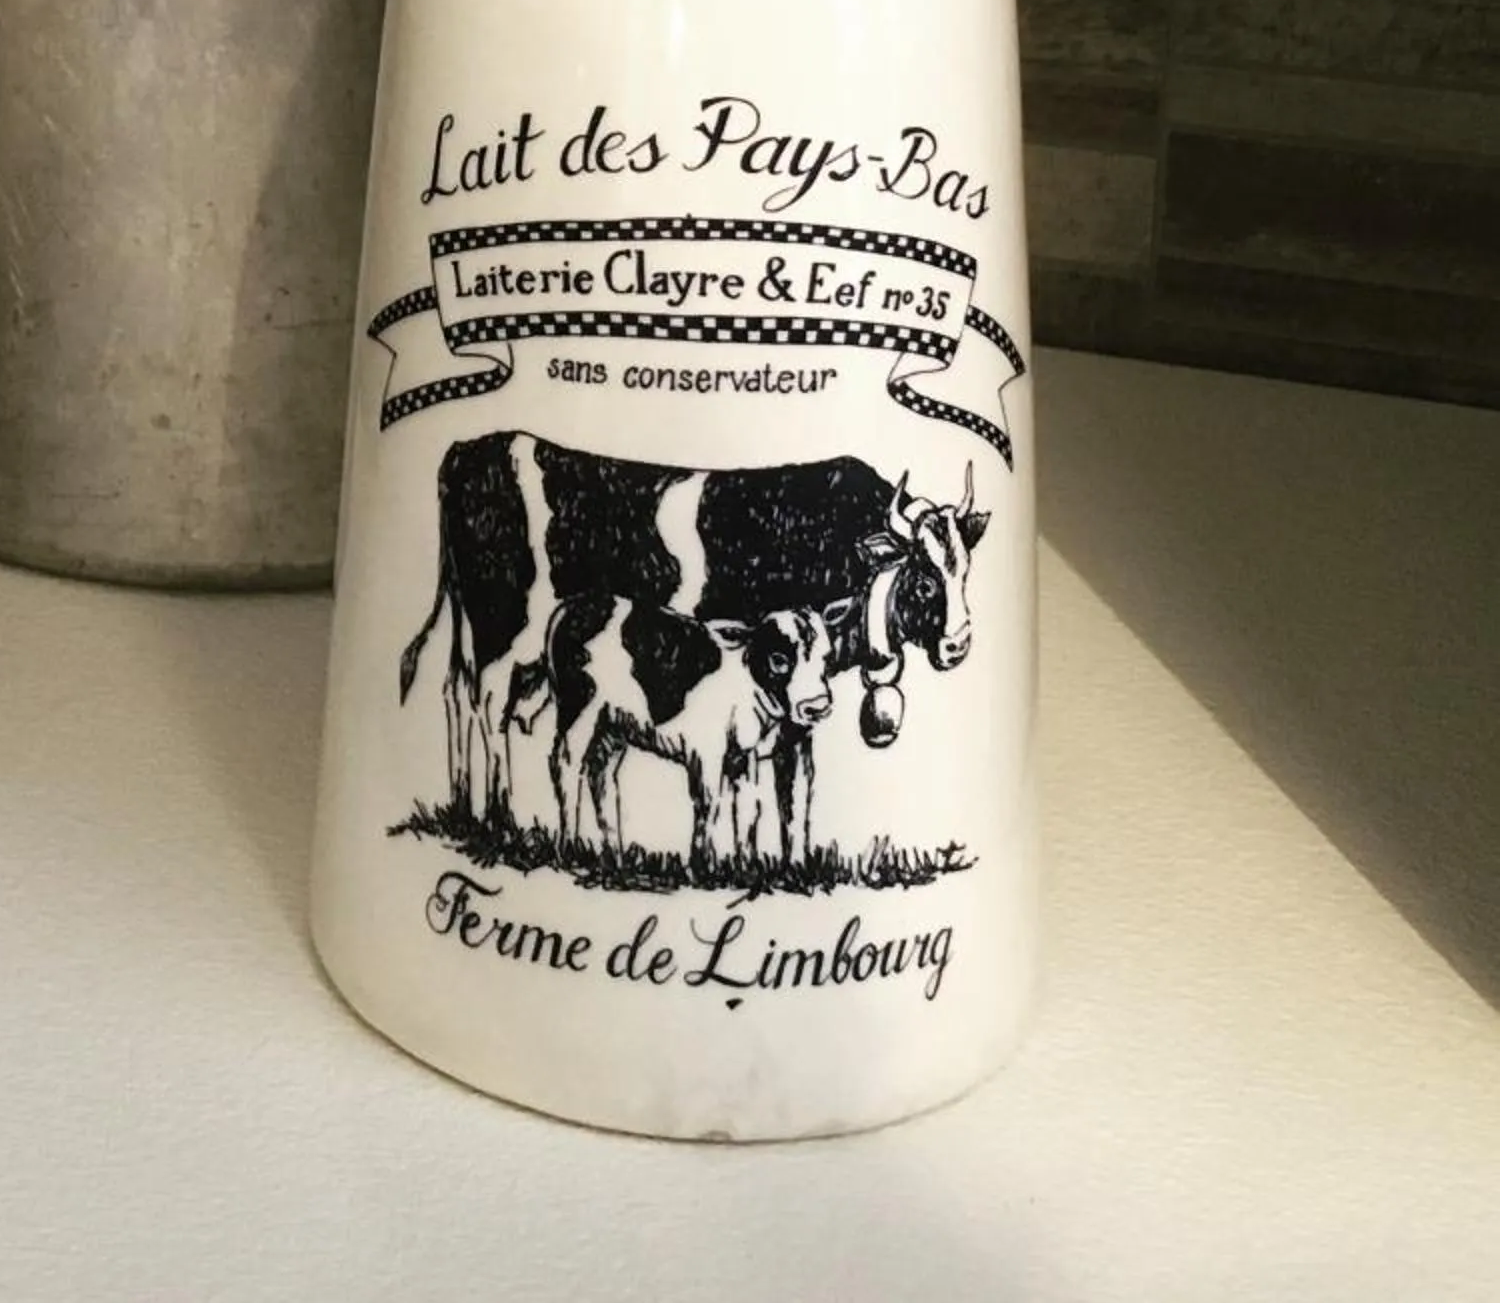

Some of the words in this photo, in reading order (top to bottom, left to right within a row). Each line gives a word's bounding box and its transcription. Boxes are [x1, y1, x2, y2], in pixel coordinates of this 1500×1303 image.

[421, 113, 545, 205] Lait
[559, 106, 669, 175] des
[682, 96, 991, 219] Pays-Bas
[451, 260, 594, 299] Laiterie
[603, 250, 745, 307] Clayre
[757, 256, 798, 302] &
[805, 262, 878, 310] Eef
[546, 355, 608, 385] sans
[622, 362, 838, 395] conservateur
[425, 871, 592, 972] Ferme
[605, 915, 677, 987] de
[683, 914, 953, 1001] Limbourg
